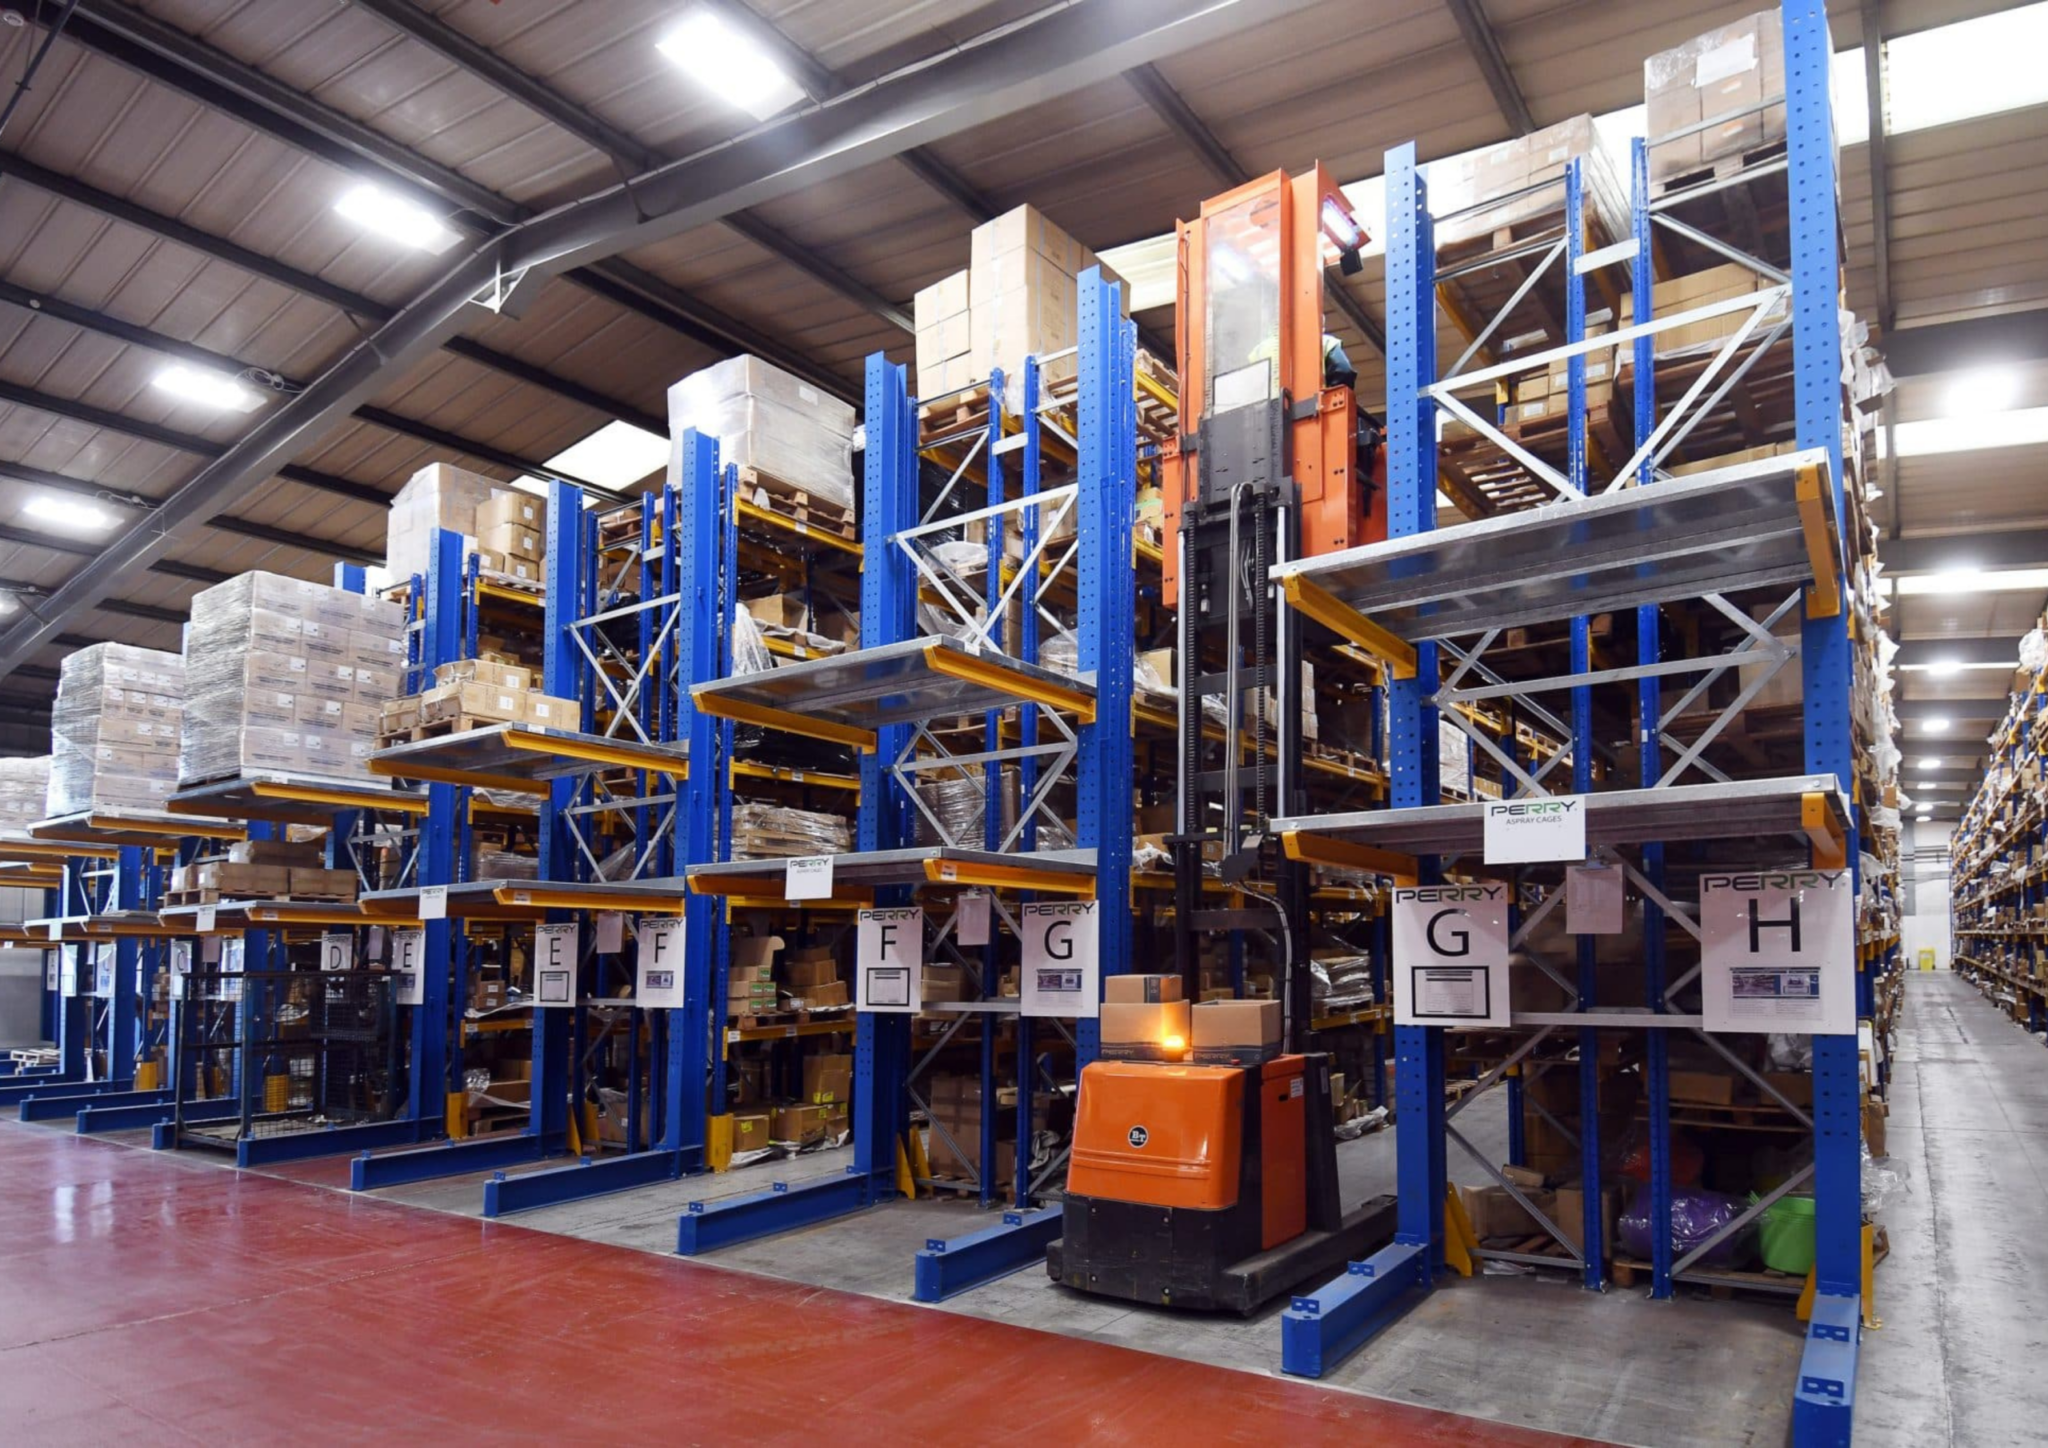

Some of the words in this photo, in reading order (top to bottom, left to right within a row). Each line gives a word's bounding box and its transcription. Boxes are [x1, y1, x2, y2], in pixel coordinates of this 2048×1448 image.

[1490, 801, 1576, 816] PERRY
[1506, 816, 1535, 825] ASPRAY
[1704, 872, 1844, 892] PERRY
[1396, 886, 1502, 904] PERRY
[860, 909, 920, 921] PERRY
[1024, 903, 1094, 917] PERRY
[537, 924, 577, 935] PERRY
[641, 918, 683, 930] PERRY
[1427, 908, 1470, 957] G
[1749, 897, 1801, 952] H
[655, 933, 667, 963] F
[881, 925, 897, 960] F
[1044, 920, 1073, 960] G
[331, 946, 341, 969] D
[403, 943, 412, 967] E
[550, 937, 561, 965] E
[1132, 1130, 1146, 1142] BT
